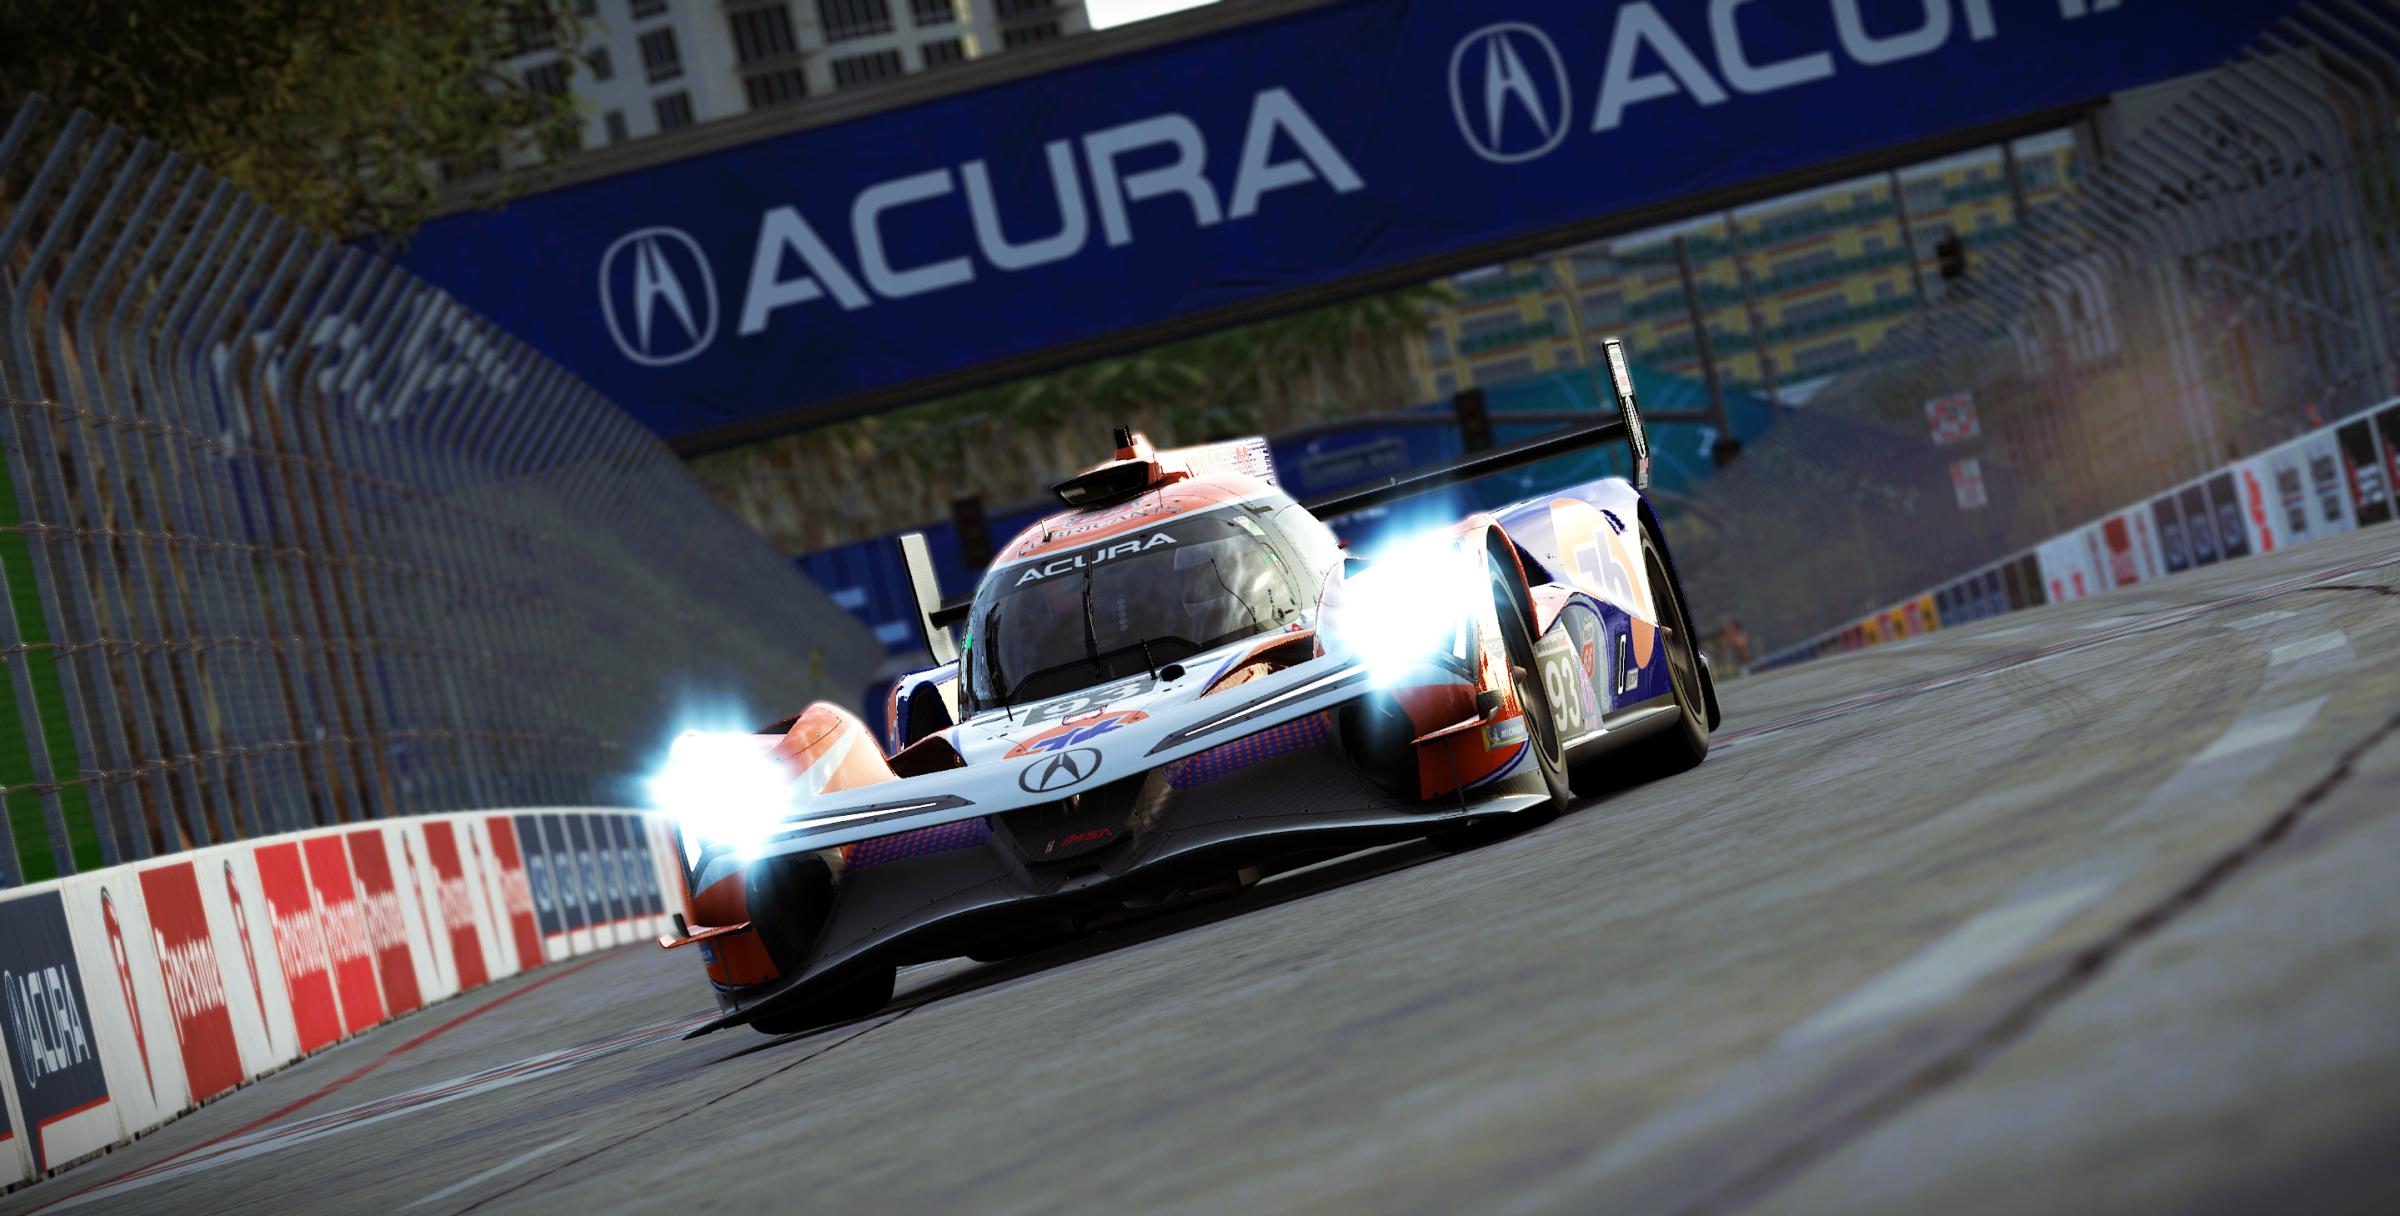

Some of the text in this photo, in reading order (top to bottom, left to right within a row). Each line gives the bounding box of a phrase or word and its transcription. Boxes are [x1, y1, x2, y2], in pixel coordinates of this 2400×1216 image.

[1591, 0, 2124, 133] ACU
[737, 86, 1366, 336] ACURA
[1014, 532, 1178, 588] ACURA
[1545, 656, 1581, 732] 93
[18, 963, 91, 1079] ACURA
[154, 926, 227, 1046] Firestone
